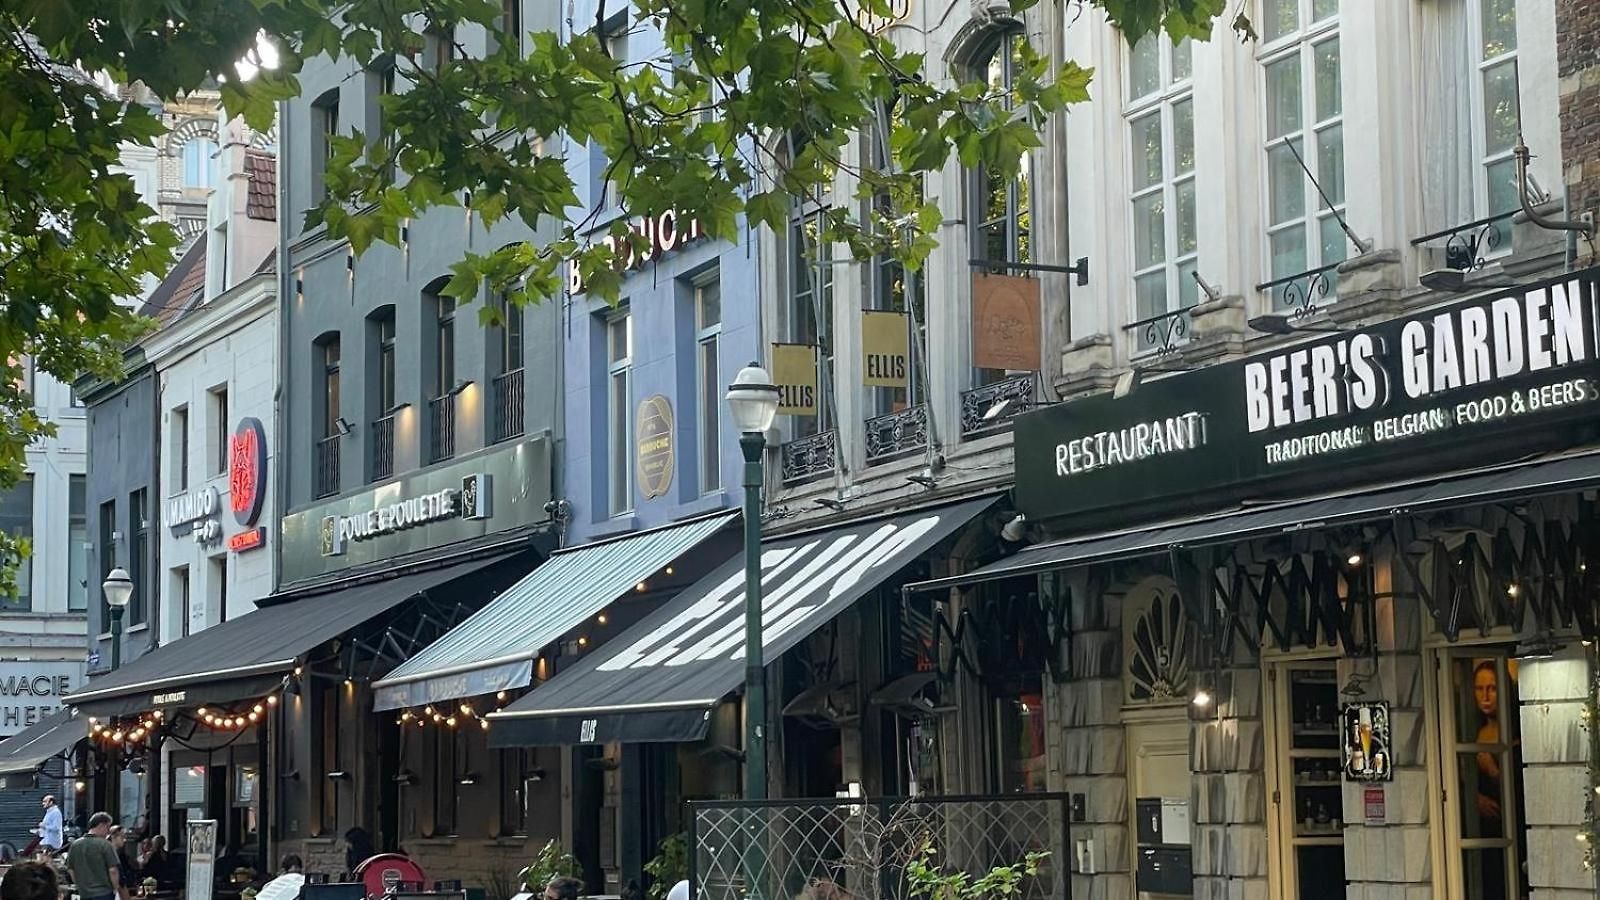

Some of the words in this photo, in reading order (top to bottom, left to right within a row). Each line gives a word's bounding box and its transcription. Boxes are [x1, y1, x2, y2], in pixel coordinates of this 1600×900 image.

[867, 353, 905, 379] ELLIS
[1245, 333, 1382, 433] BEER'S
[1401, 279, 1584, 399] GARDEN
[778, 384, 813, 408] ELLIS
[1055, 410, 1201, 476] RESTAURANT
[1265, 424, 1362, 464] TRADITIONAL
[1374, 413, 1443, 443] BELGIAN
[1456, 395, 1506, 425] FOOD
[1511, 392, 1525, 414] &
[1530, 379, 1585, 410] BEERS
[163, 487, 214, 528] UMAMIDO
[339, 511, 376, 541] POULE
[377, 509, 389, 530] &
[389, 489, 455, 530] POULETTE
[4, 705, 61, 727] HEE
